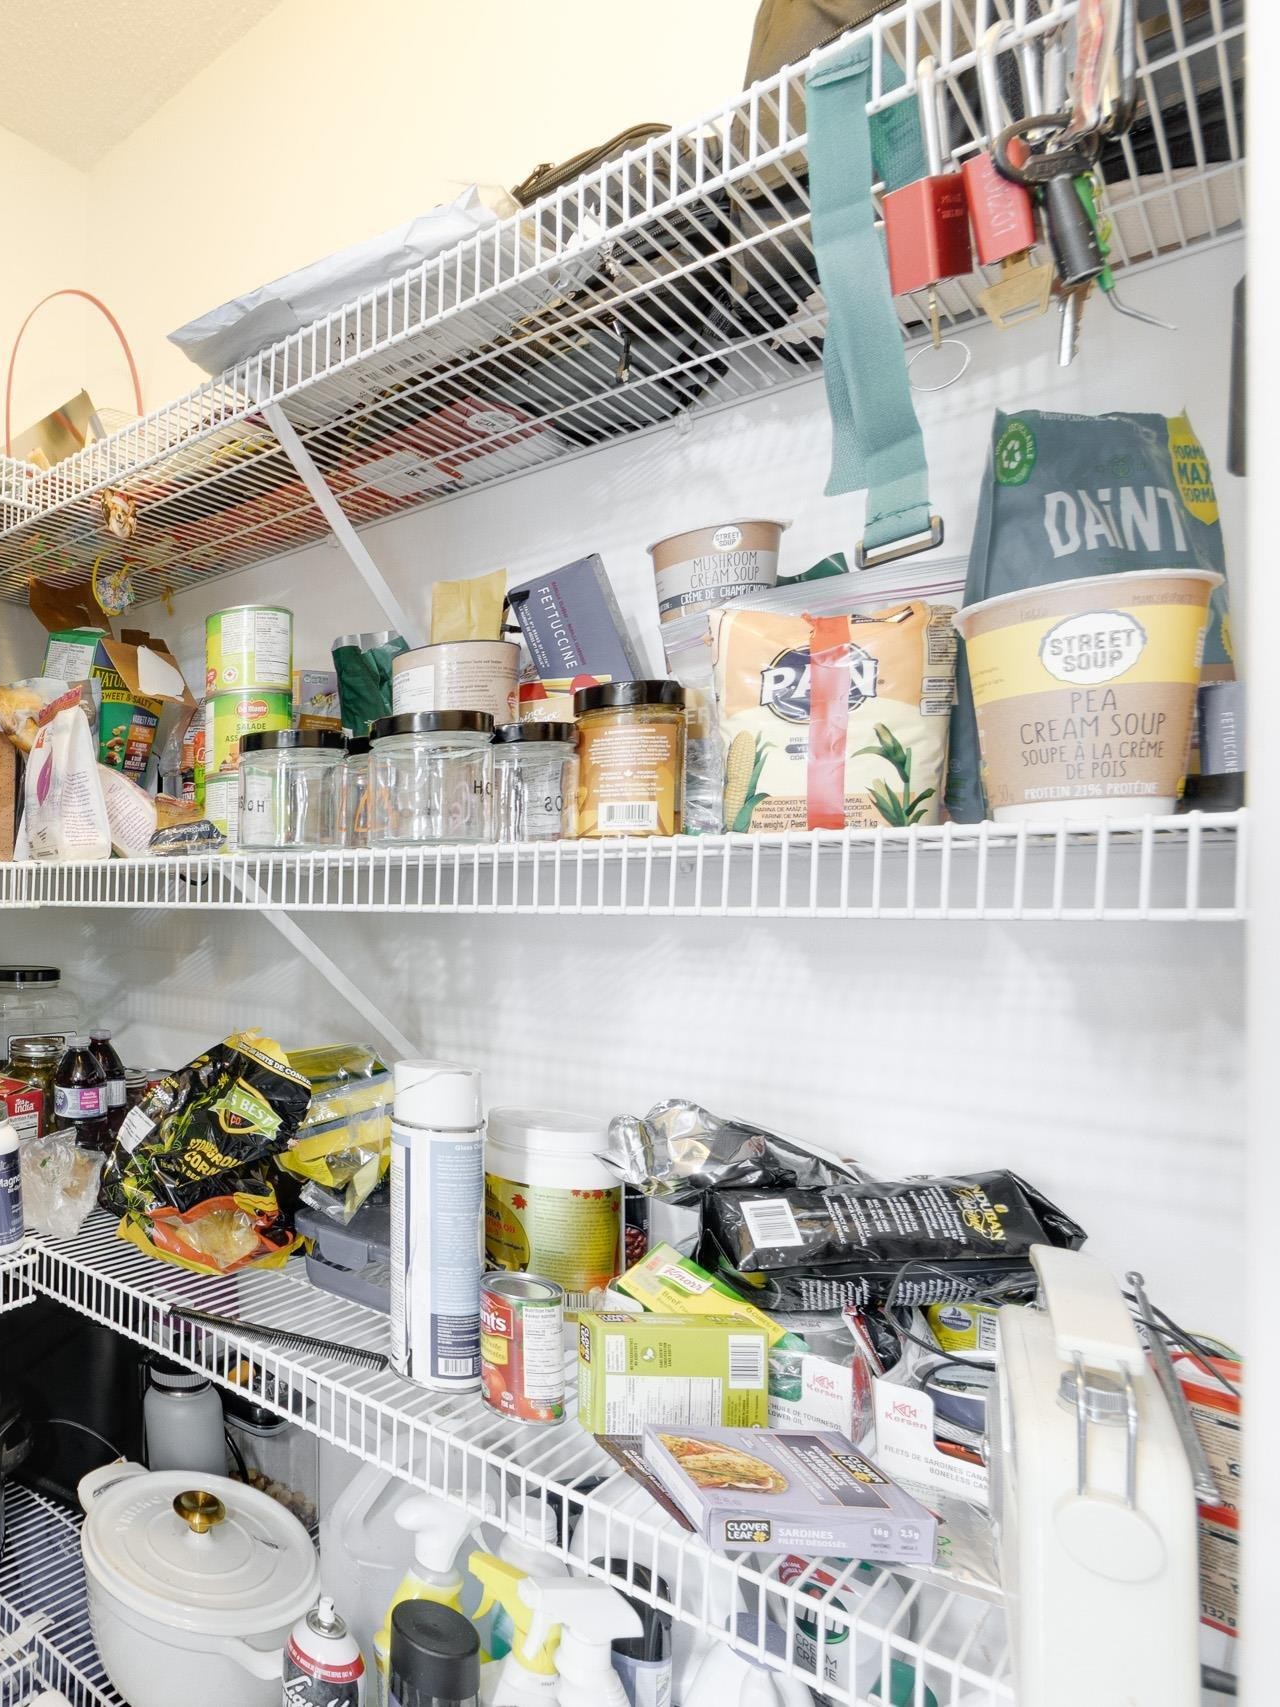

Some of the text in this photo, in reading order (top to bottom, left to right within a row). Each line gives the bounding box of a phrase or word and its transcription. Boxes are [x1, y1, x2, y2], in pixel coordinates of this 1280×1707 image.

[715, 531, 740, 542] STREET
[693, 552, 757, 574] MUSHROOM
[690, 566, 760, 589] CREAM SOUP
[538, 586, 578, 670] FETTUCCINE
[1050, 629, 1135, 656] STREET
[1062, 650, 1123, 673] SOUP
[101, 692, 126, 702] SWEET
[132, 694, 154, 708] SALTY
[1070, 688, 1118, 714] PEA
[236, 722, 267, 735] SALADE
[1019, 712, 1167, 745] CREAM SOUP
[1022, 745, 1070, 767] SOUPE
[1092, 743, 1112, 760] LA
[1119, 738, 1165, 759] CRÈME
[1220, 711, 1239, 773] FETTUCCINE
[1065, 760, 1127, 780] DE POIS
[1024, 785, 1070, 801] PROTEIN
[1106, 781, 1158, 797] PROTÉINE
[751, 819, 763, 829] Net
[763, 819, 785, 831] weight
[790, 819, 807, 828] Peso
[14, 1102, 34, 1114] India
[240, 1099, 275, 1126] BEST
[184, 1150, 222, 1177] CORN
[663, 1264, 704, 1293] Knorr
[661, 1290, 680, 1307] Beef
[792, 1409, 843, 1432] DE TOURNESOL
[792, 1417, 804, 1428] OIL
[883, 1443, 965, 1476] FILETS DE SARDINES
[929, 1466, 968, 1486] BONELESS
[726, 1521, 770, 1533] CLOVER
[727, 1531, 754, 1540] LEAF
[777, 1527, 834, 1541] SARDINES
[872, 1527, 883, 1536] 16
